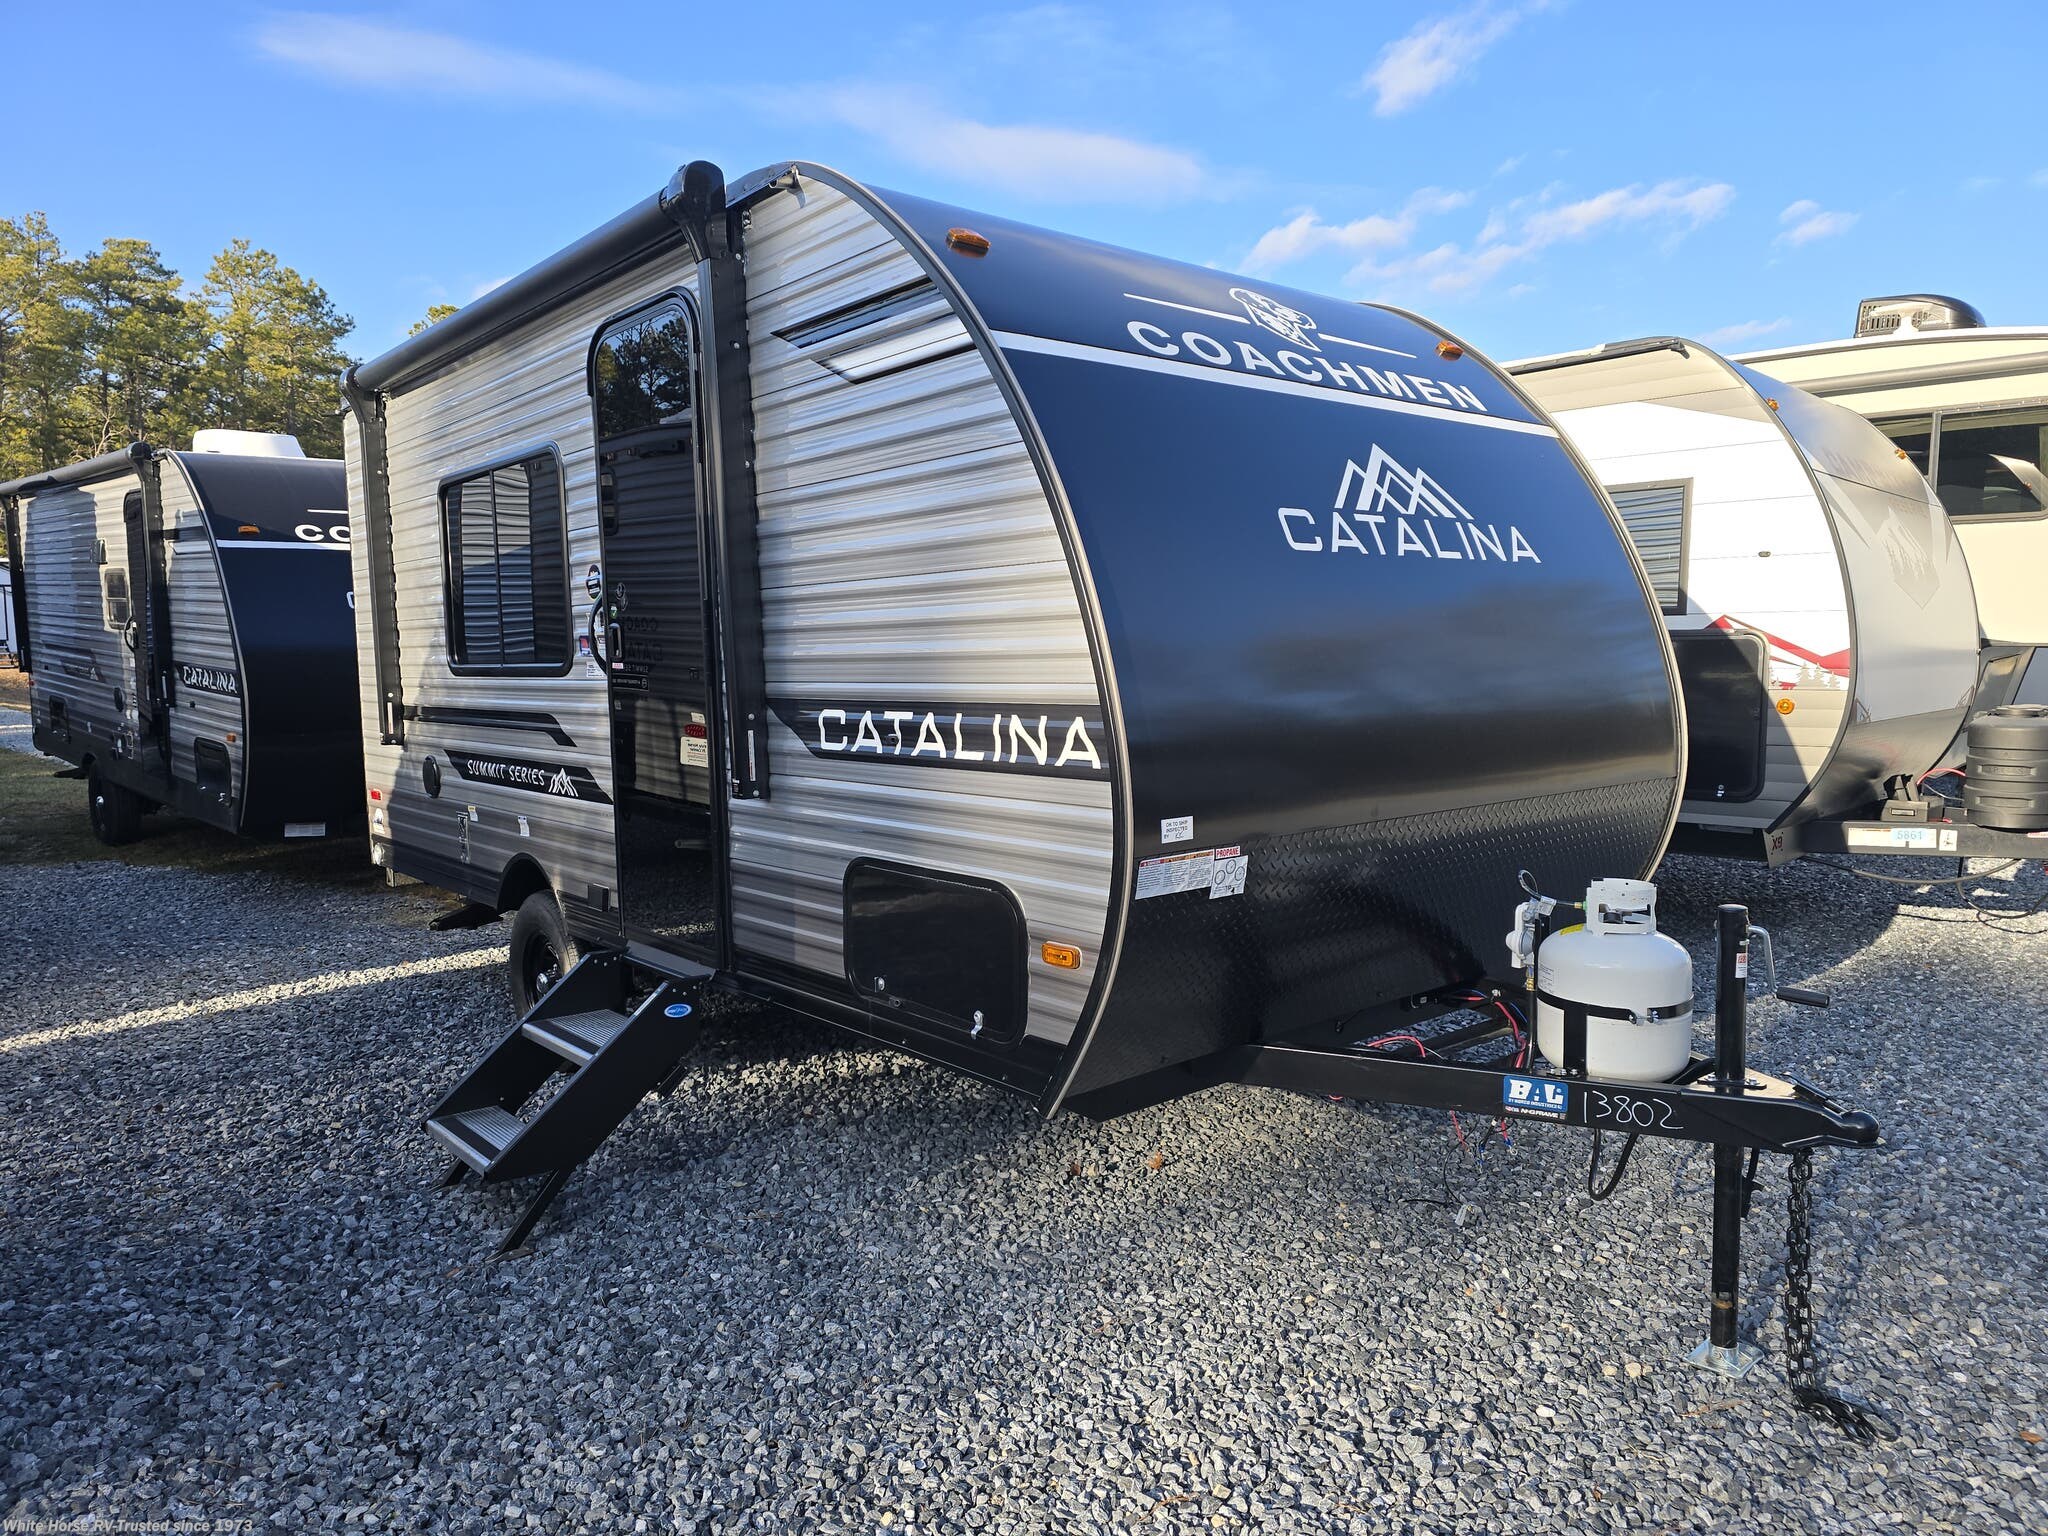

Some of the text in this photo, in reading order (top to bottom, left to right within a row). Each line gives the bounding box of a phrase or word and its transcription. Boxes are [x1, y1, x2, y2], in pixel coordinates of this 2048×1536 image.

[1127, 320, 1488, 412] COACHMEN
[1277, 507, 1542, 564] CATALINA
[183, 665, 238, 694] CATALINA
[818, 708, 1101, 770] CATALINA
[467, 759, 545, 786] SUMMIT SERIES
[1216, 847, 1239, 858] PROPANE
[1584, 1090, 1684, 1130] 13802
